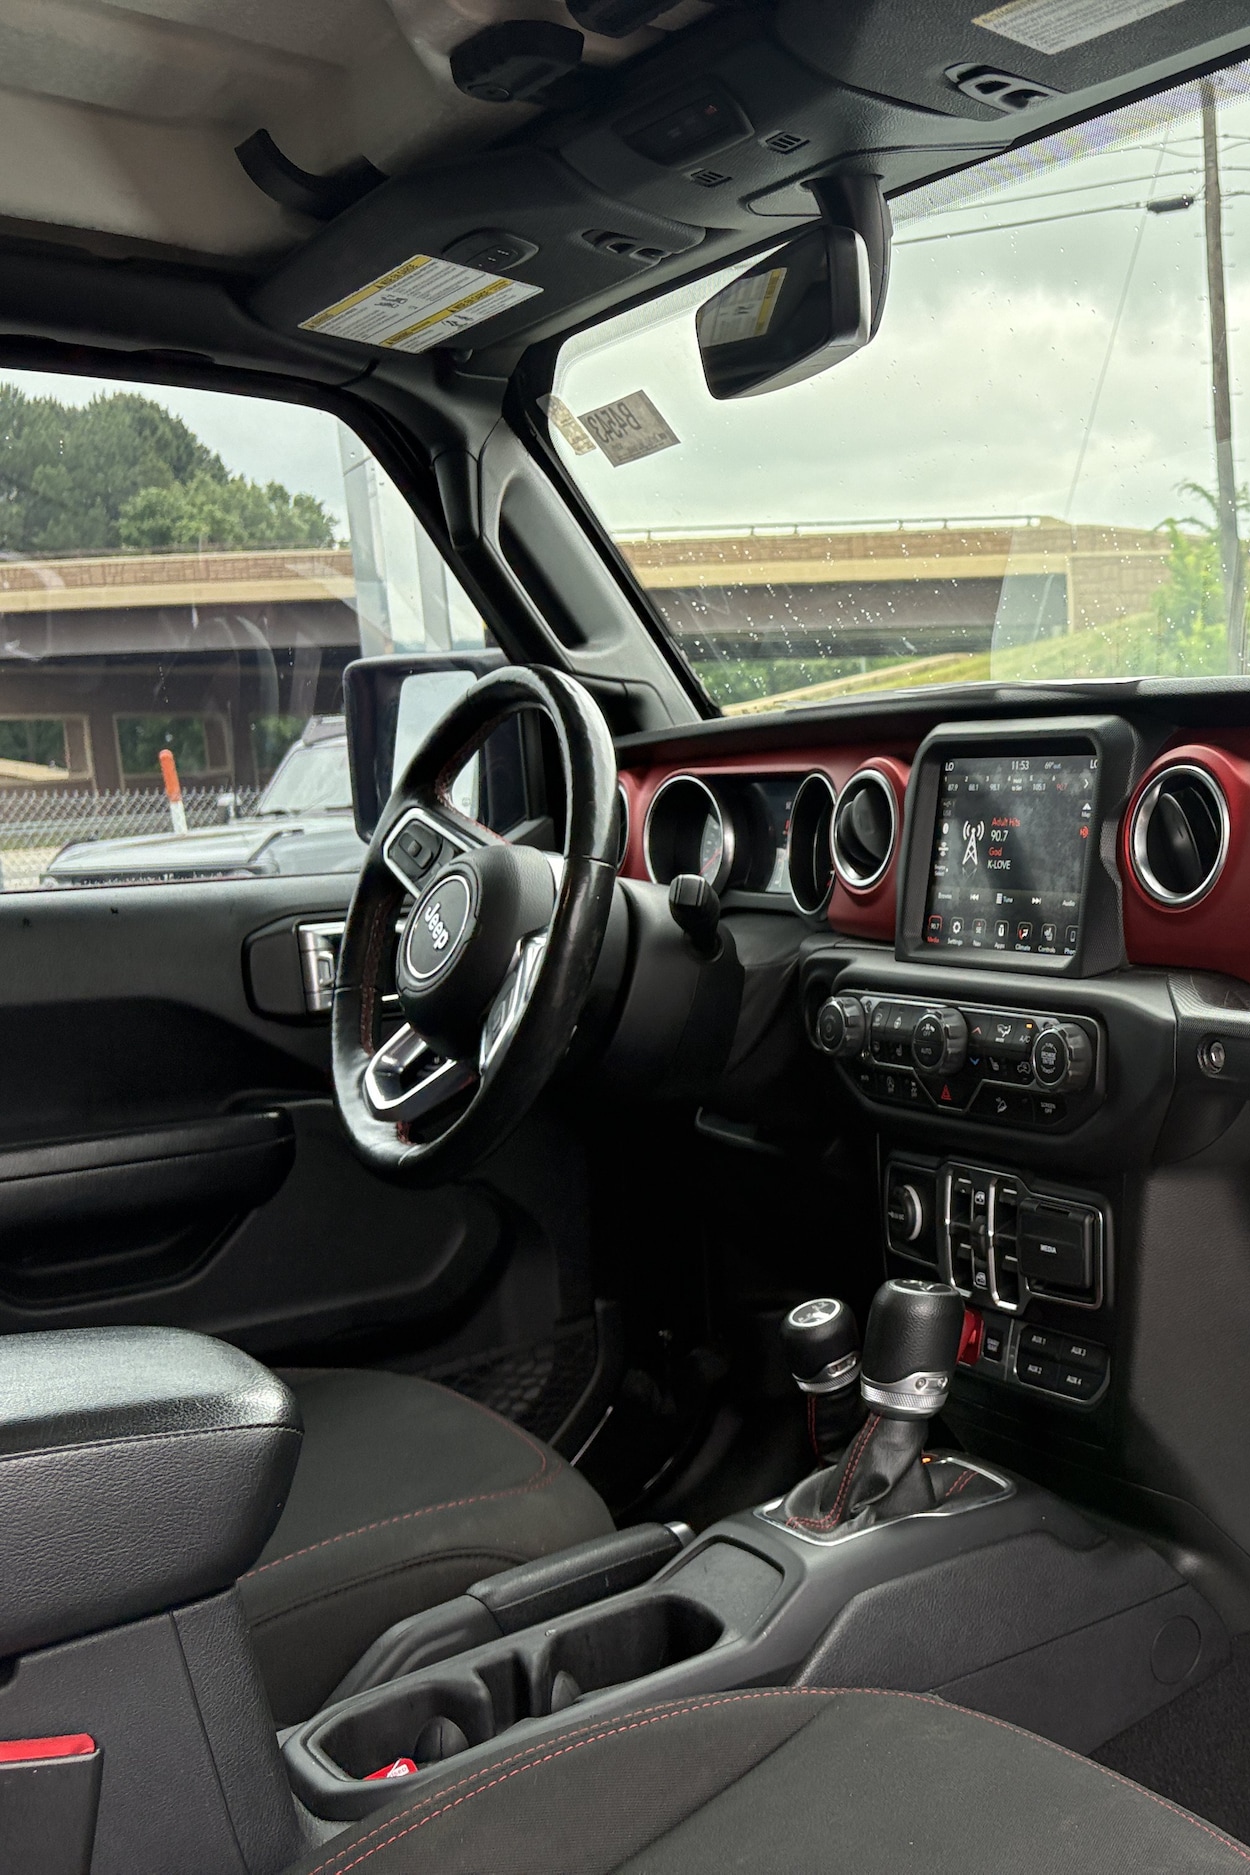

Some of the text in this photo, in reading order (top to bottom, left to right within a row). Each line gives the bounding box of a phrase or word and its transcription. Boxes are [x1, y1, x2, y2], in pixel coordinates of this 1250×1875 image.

[945, 761, 955, 772] LO
[1011, 760, 1030, 771] 11:53
[991, 817, 1021, 828] Adult Hits
[990, 829, 1009, 841] 90.7
[988, 846, 1003, 857] God
[987, 859, 1012, 870] K-LOVE
[424, 902, 450, 950] Jeep
[1019, 1034, 1031, 1043] A/C
